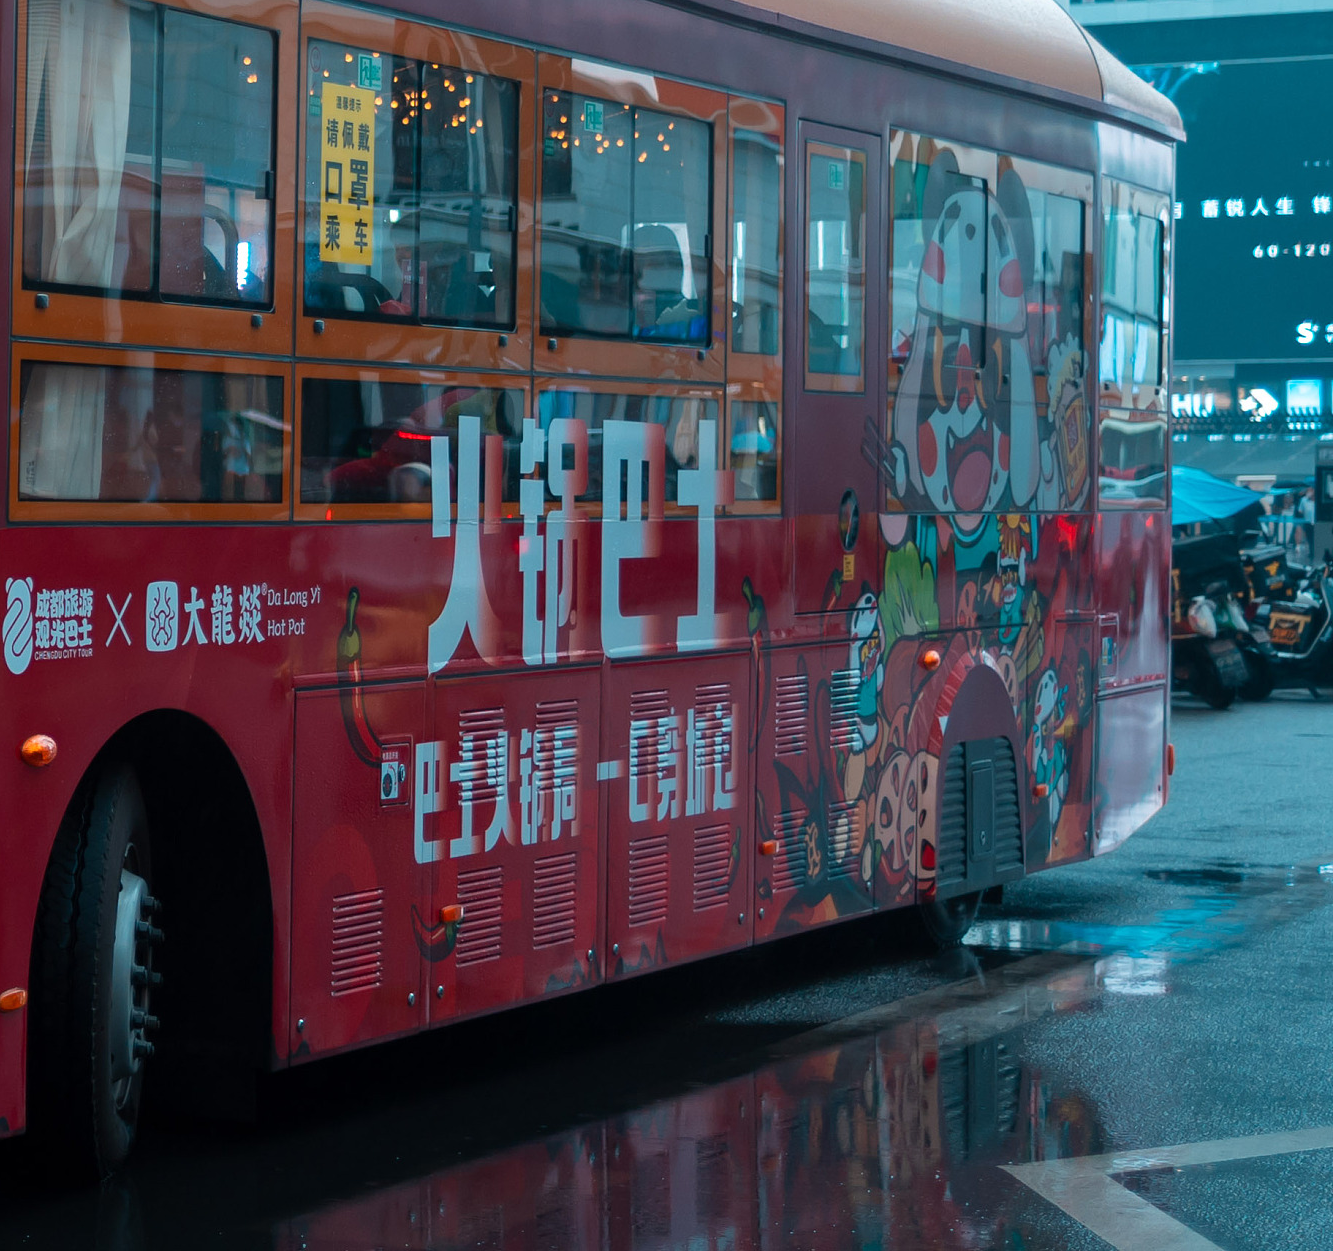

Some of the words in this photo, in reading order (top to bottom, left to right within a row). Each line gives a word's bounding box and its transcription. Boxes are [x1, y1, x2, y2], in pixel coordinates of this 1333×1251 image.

[326, 117, 371, 153] 请佩戴
[325, 158, 370, 211] 口罩
[324, 214, 369, 254] 乘车
[427, 415, 734, 678] 火锅巴士
[35, 588, 94, 619] 成都旅游
[267, 589, 282, 607] Da
[283, 588, 309, 608] Long
[35, 618, 93, 649] 观光巴士
[267, 619, 286, 637] Hot
[288, 618, 306, 636] Pot
